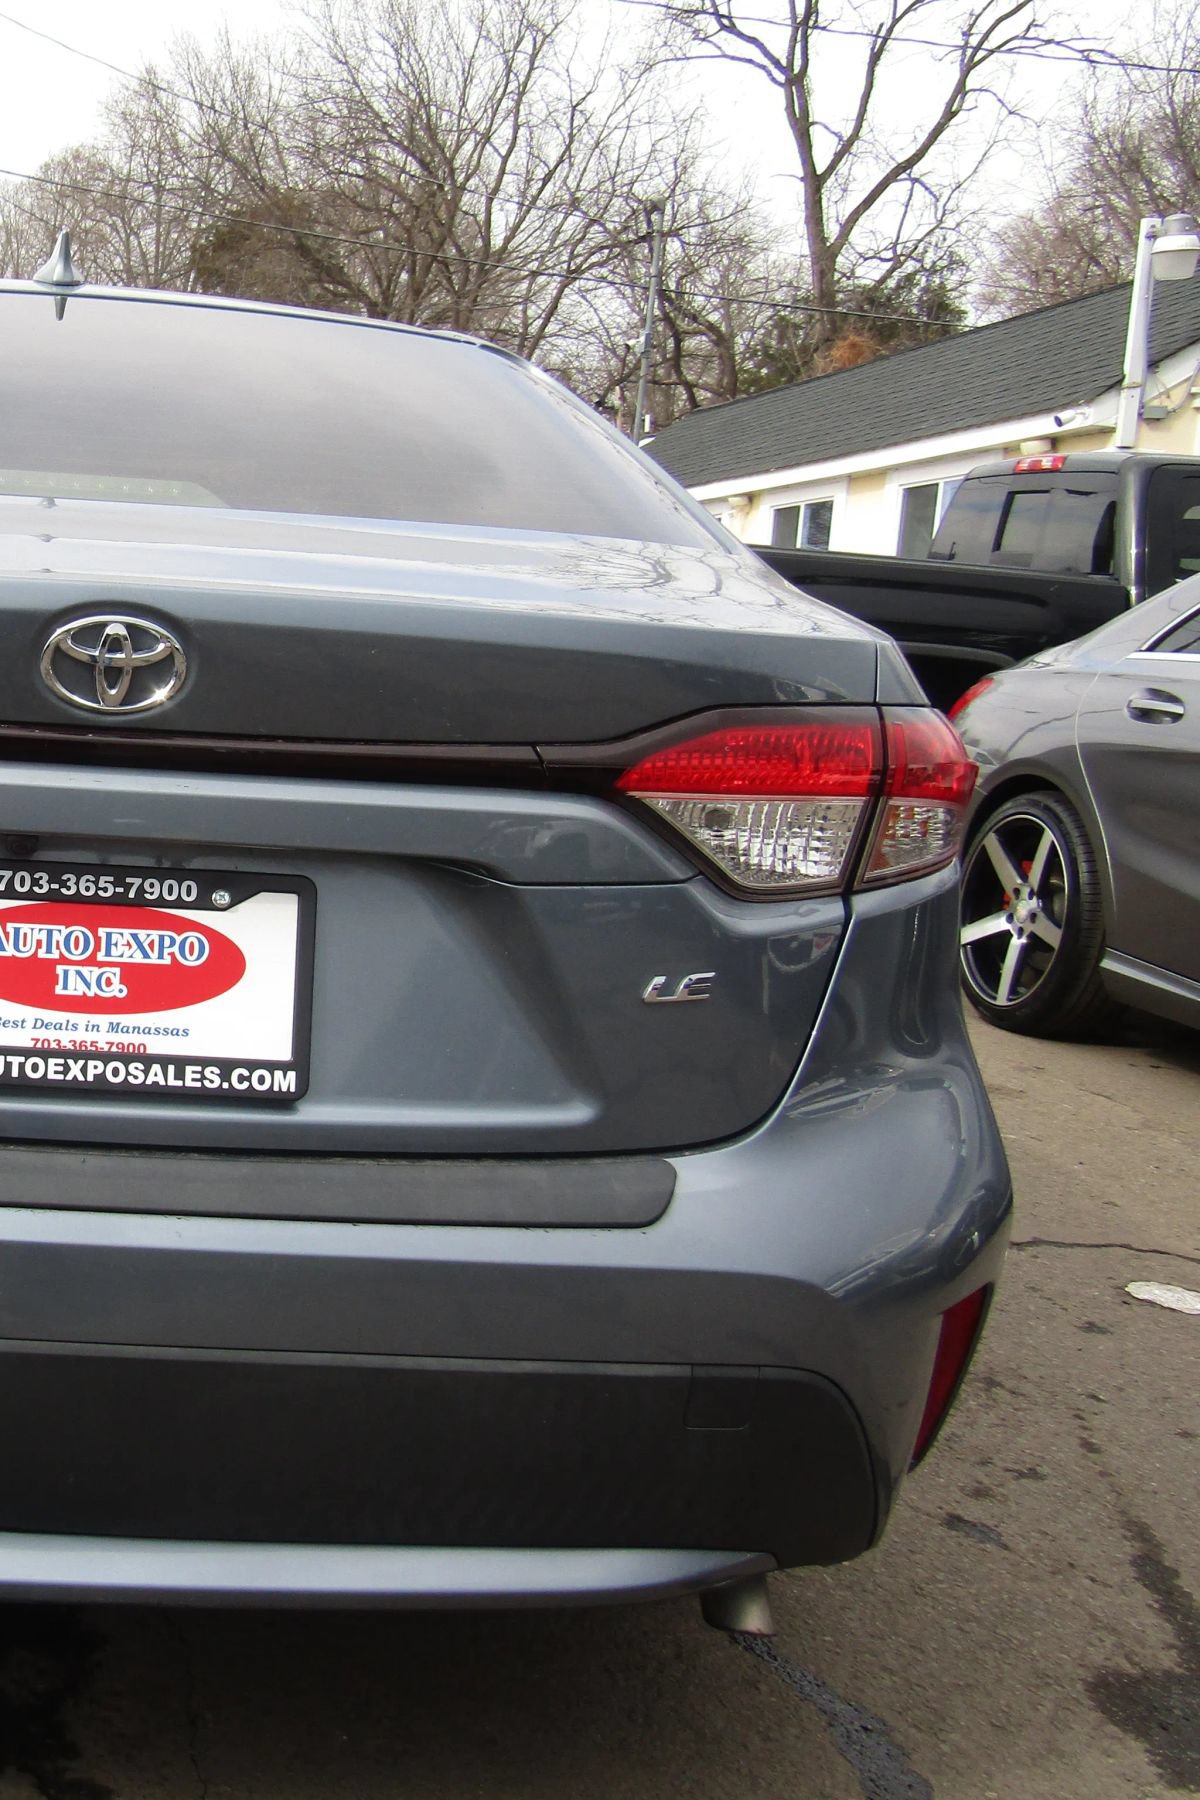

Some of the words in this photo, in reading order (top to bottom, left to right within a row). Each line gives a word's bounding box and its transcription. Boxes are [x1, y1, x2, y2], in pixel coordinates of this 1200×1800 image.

[97, 928, 209, 966] EXPO
[55, 965, 127, 997] INC.
[642, 972, 716, 1003] LE
[32, 1018, 79, 1032] Deals
[85, 1020, 100, 1033] in
[106, 1022, 190, 1037] Manassas
[30, 1038, 148, 1053] 703-365-7900
